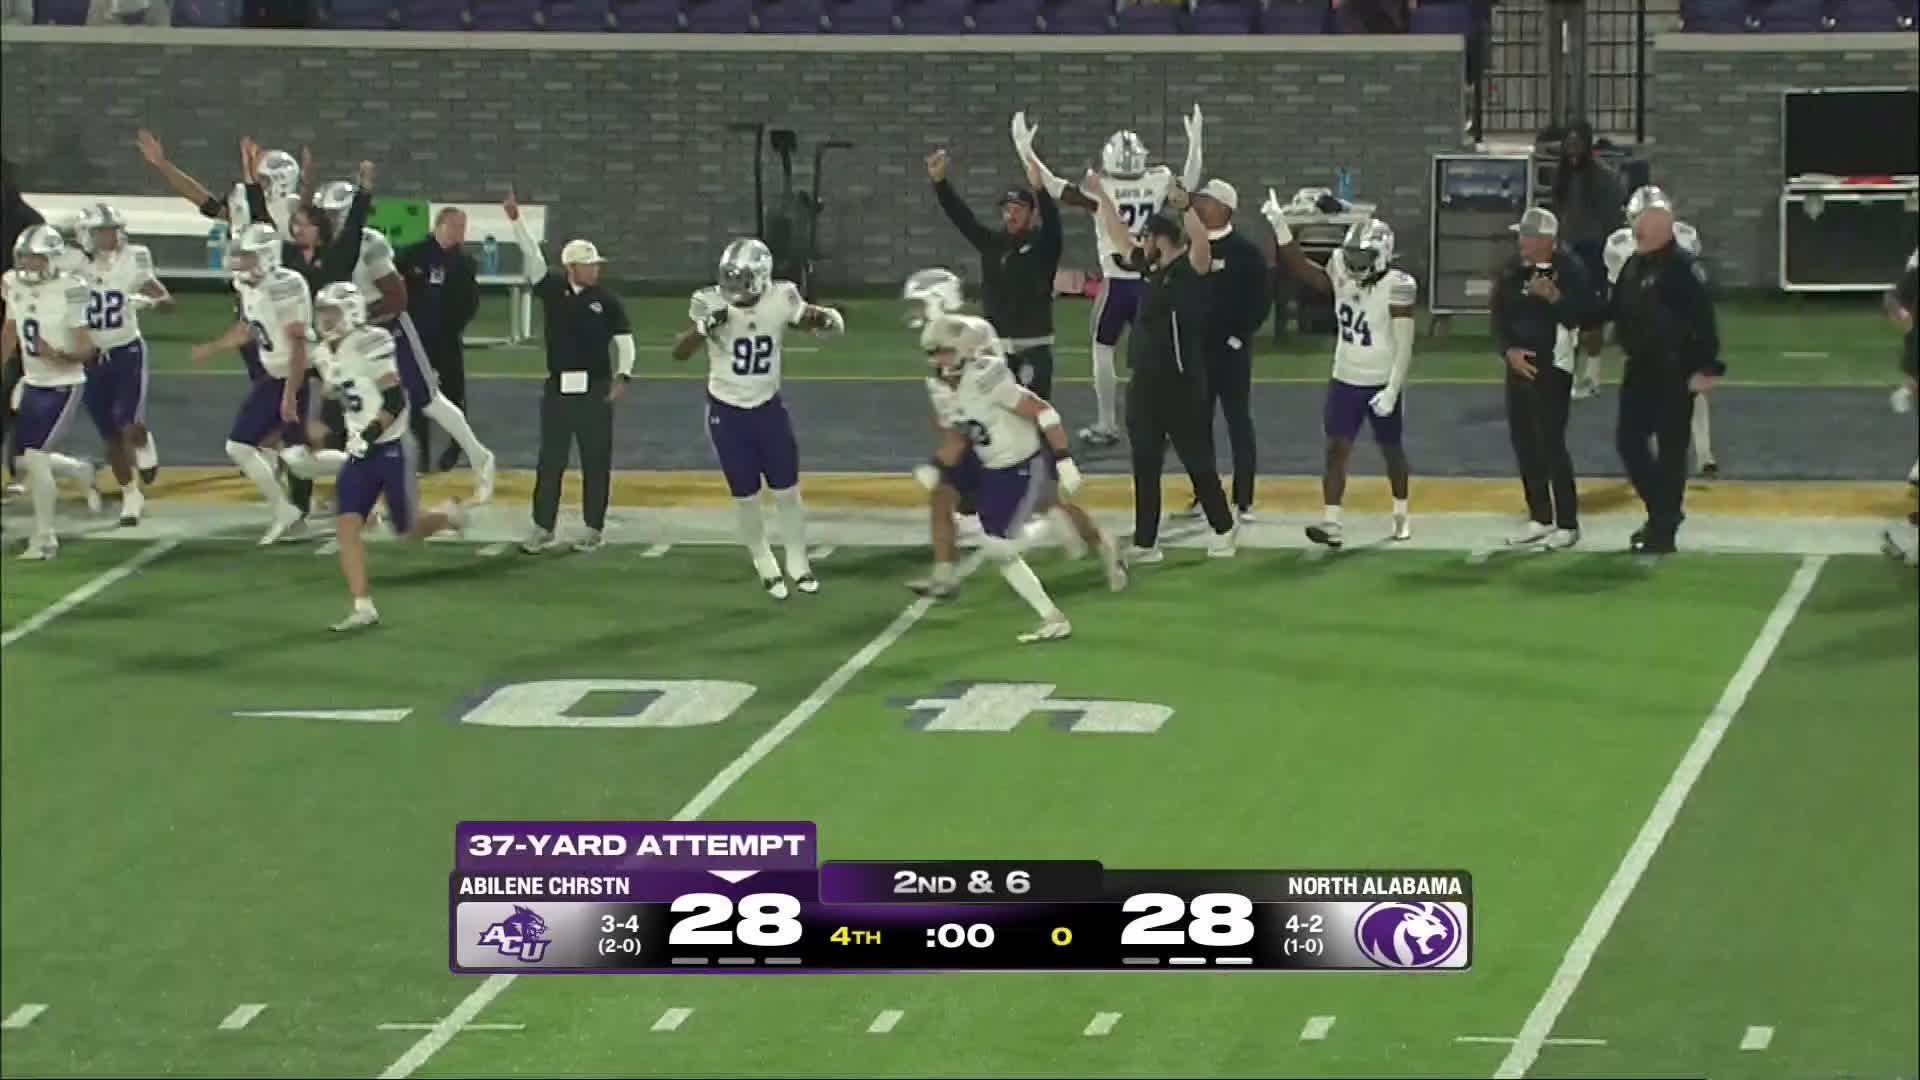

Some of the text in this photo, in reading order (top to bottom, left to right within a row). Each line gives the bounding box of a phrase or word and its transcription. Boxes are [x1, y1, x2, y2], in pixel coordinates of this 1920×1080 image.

[86, 289, 124, 328] 22
[1339, 304, 1372, 346] 24
[732, 334, 773, 375] 92
